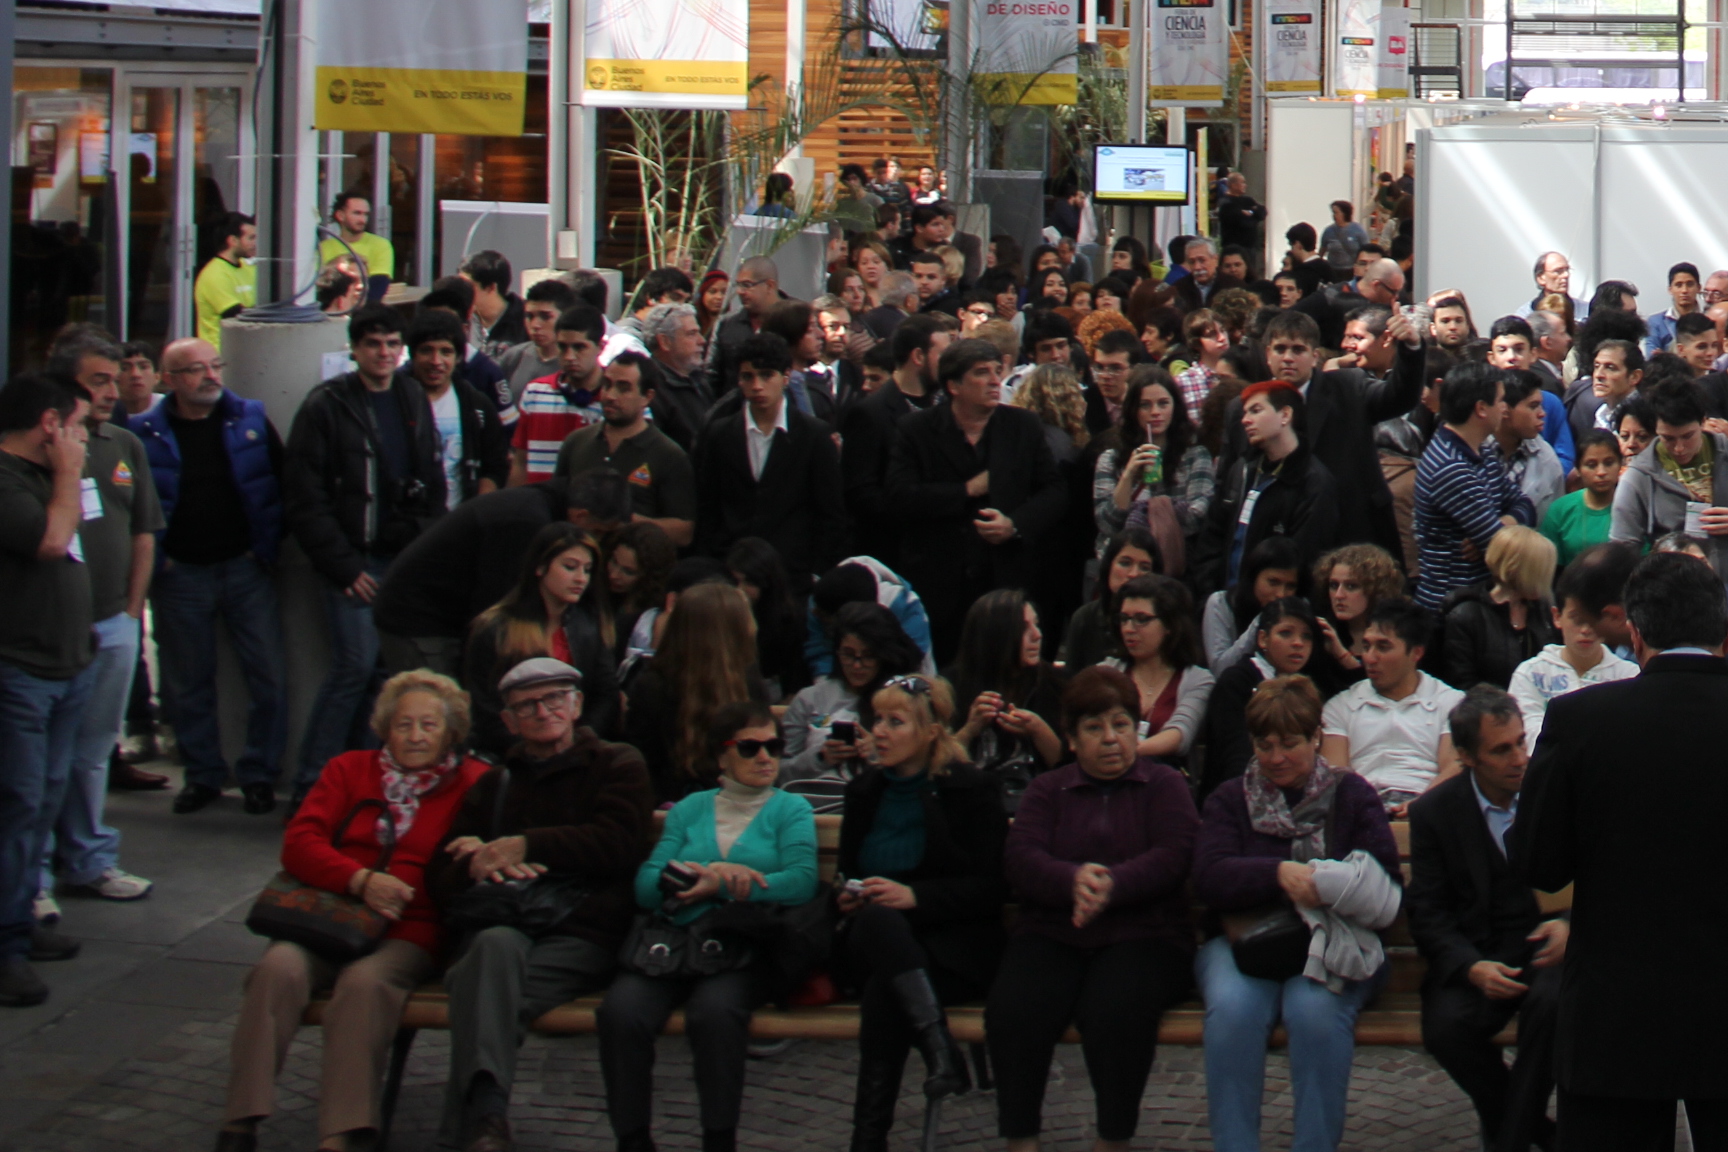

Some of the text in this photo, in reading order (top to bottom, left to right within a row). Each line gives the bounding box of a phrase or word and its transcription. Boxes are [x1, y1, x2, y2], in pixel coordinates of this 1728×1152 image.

[987, 1, 1071, 16] DE DISEÑO
[1165, 15, 1206, 30] CIENCIA
[611, 66, 645, 75] Buenos
[352, 79, 386, 89] Buenos
[611, 75, 633, 83] Aires
[611, 83, 643, 91] Ciudad
[414, 90, 428, 99] EN
[492, 91, 513, 102] VOS
